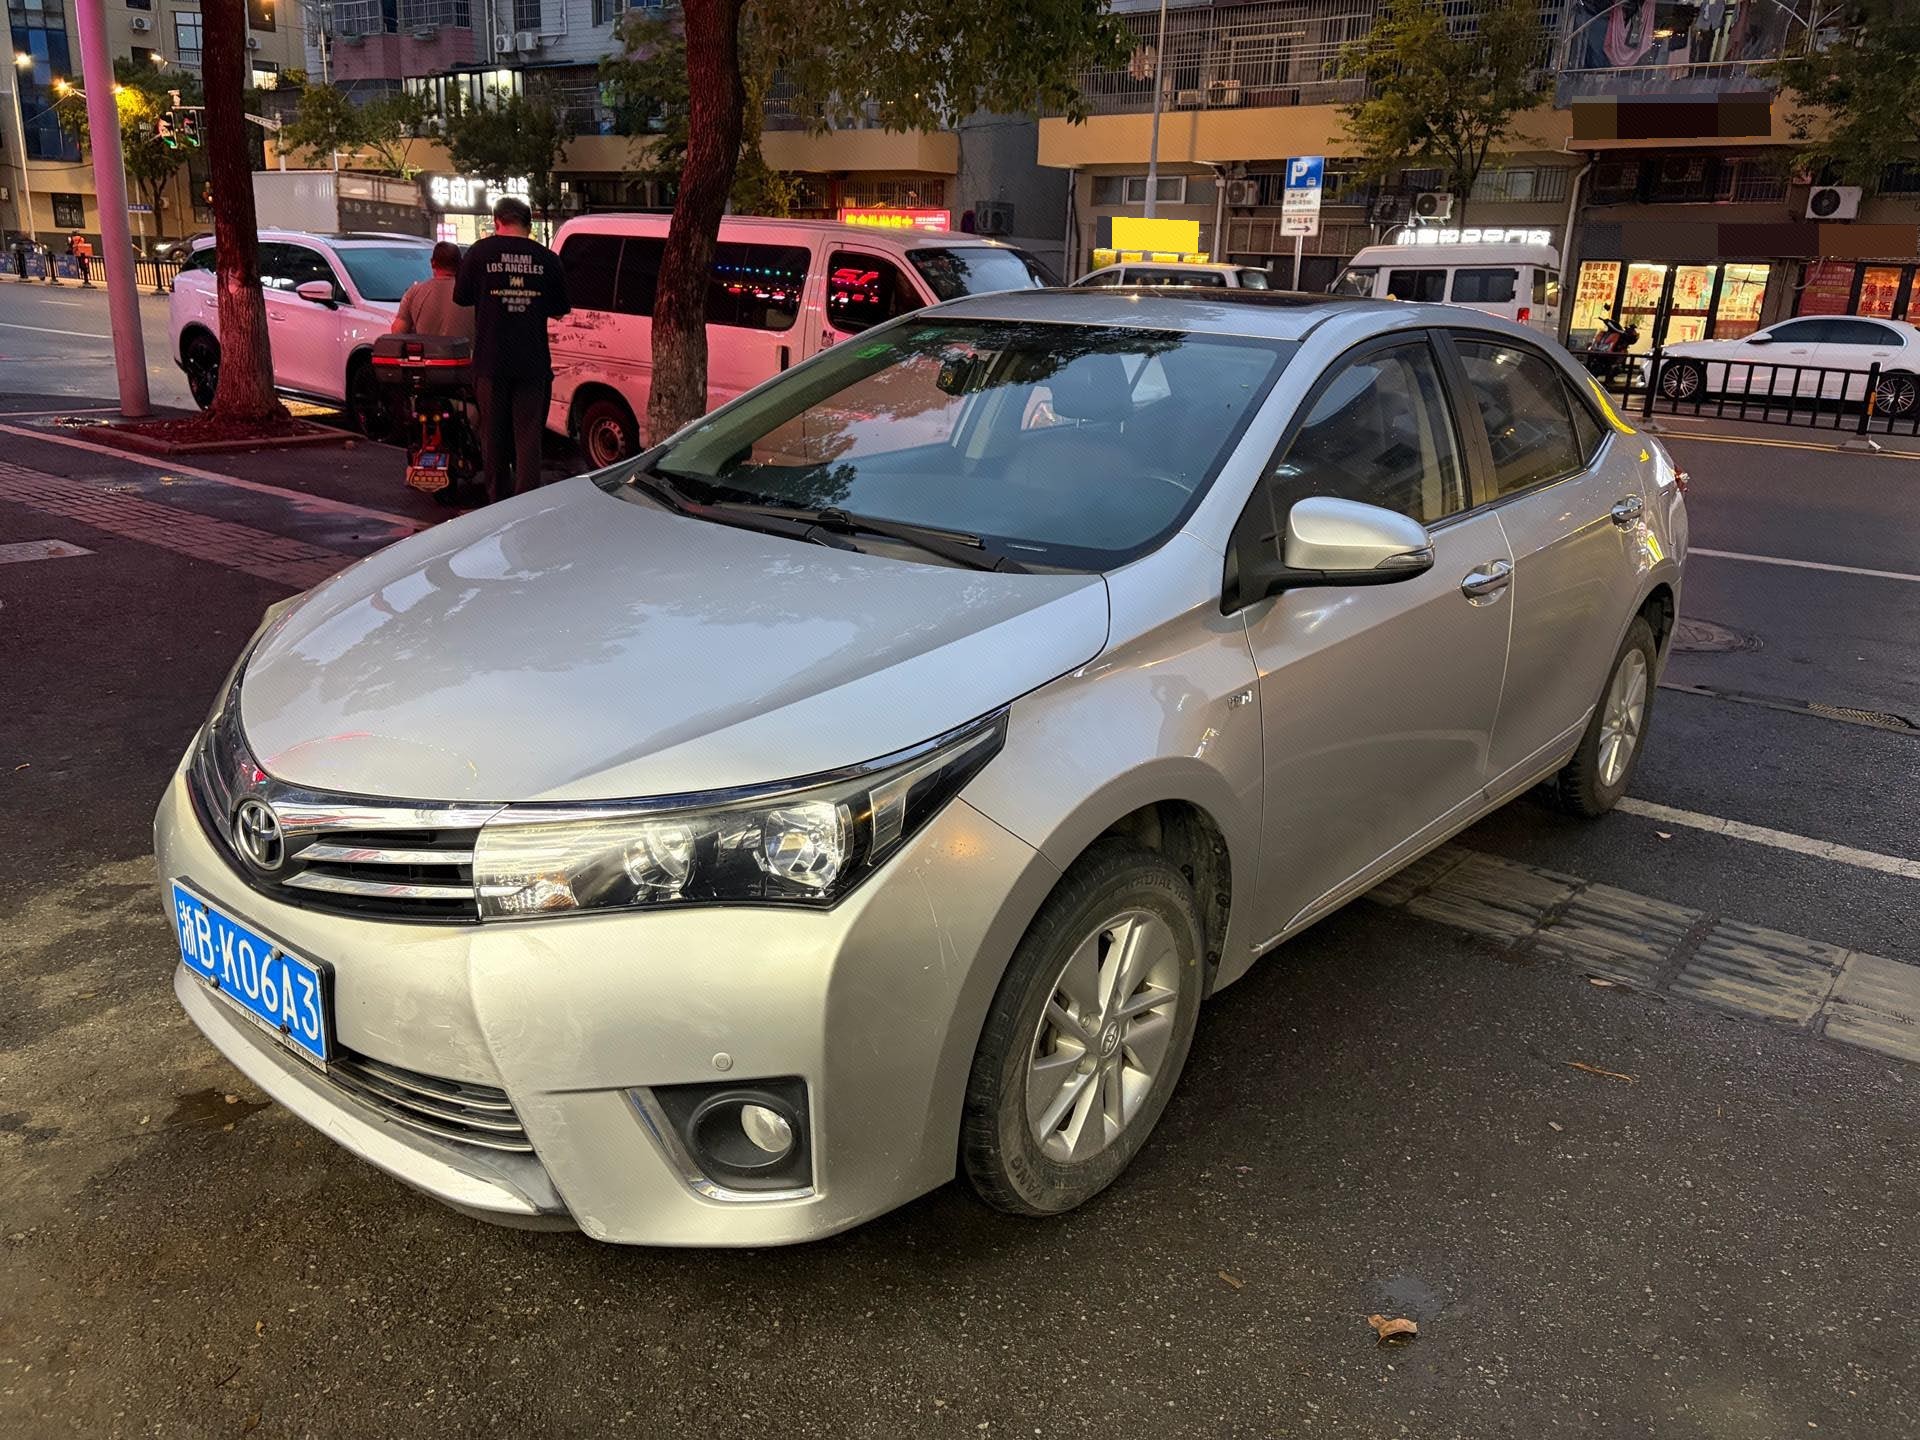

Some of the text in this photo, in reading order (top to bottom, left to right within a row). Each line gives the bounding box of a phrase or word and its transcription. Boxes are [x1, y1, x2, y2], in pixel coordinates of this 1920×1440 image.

[1290, 161, 1309, 186] P
[501, 253, 532, 264] MIAMI
[486, 263, 544, 275] LOS ANGELES
[178, 900, 319, 1041] 浙B·K06A3
